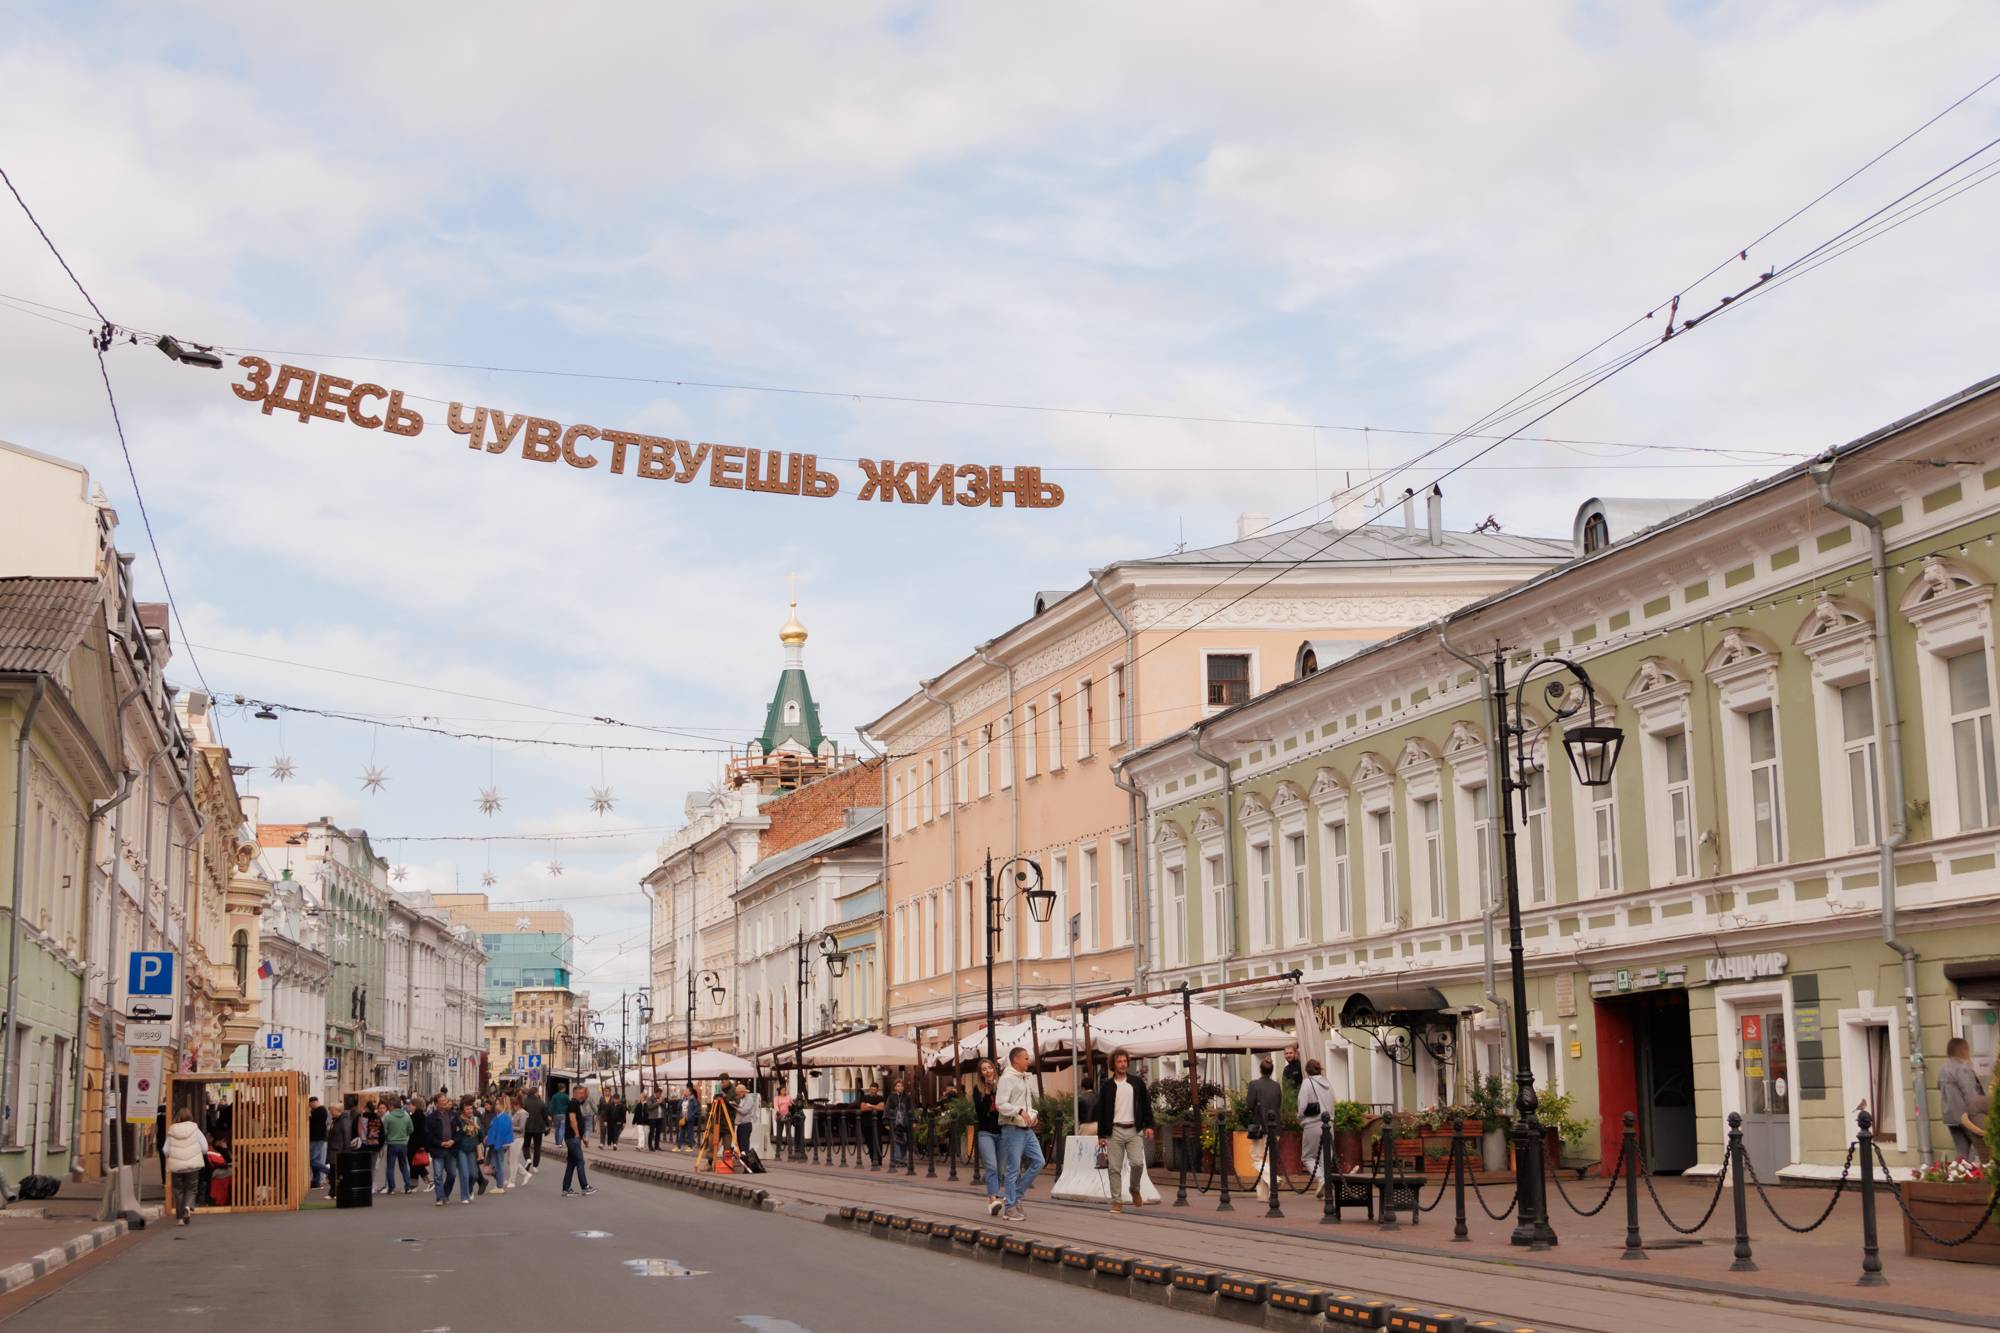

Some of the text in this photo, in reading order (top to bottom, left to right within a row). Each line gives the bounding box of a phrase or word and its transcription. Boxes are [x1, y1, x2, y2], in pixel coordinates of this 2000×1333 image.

[231, 356, 1065, 508] ЗДЕСЬ ЧУВСТВУЕШЬ ЖИЗНЬ
[1705, 952, 1789, 981] КАНЦМИР
